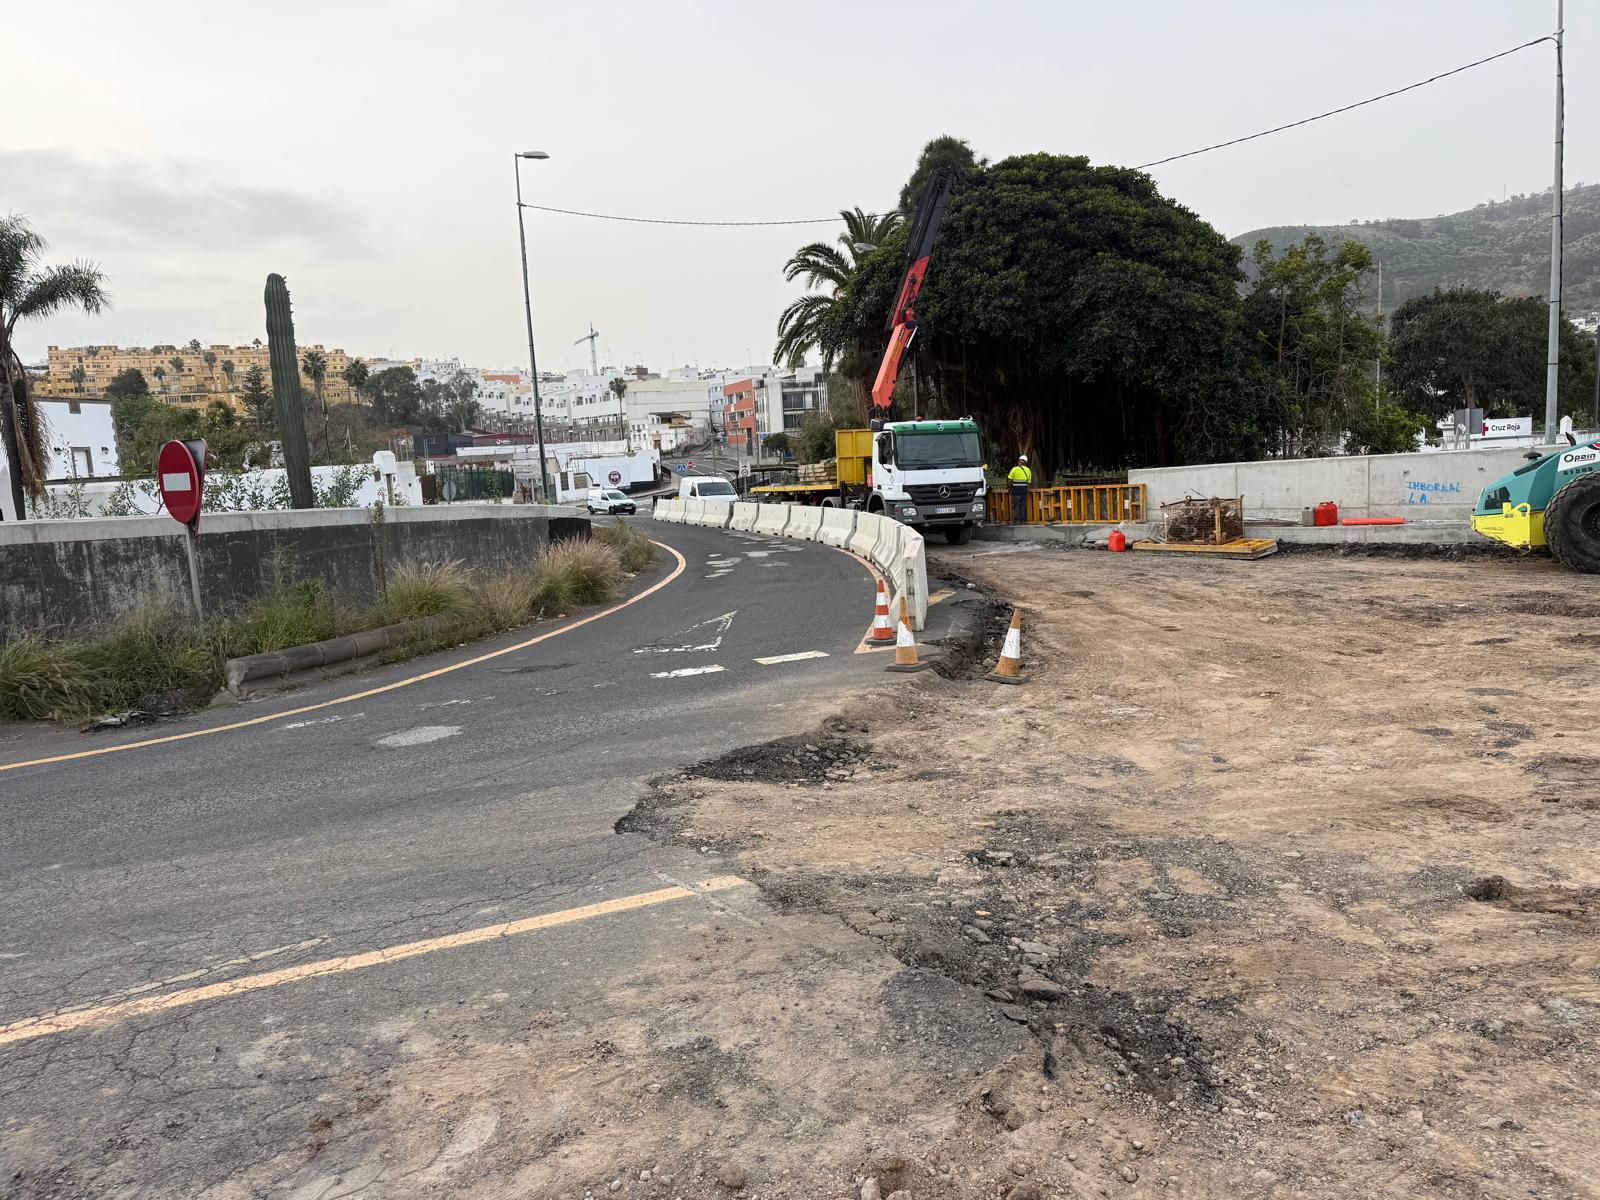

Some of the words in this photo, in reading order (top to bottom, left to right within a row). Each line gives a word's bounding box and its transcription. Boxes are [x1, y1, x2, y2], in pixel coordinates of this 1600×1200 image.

[1491, 424, 1506, 432] Cruz
[1507, 423, 1521, 432] Roja
[1563, 453, 1596, 463] Opein
